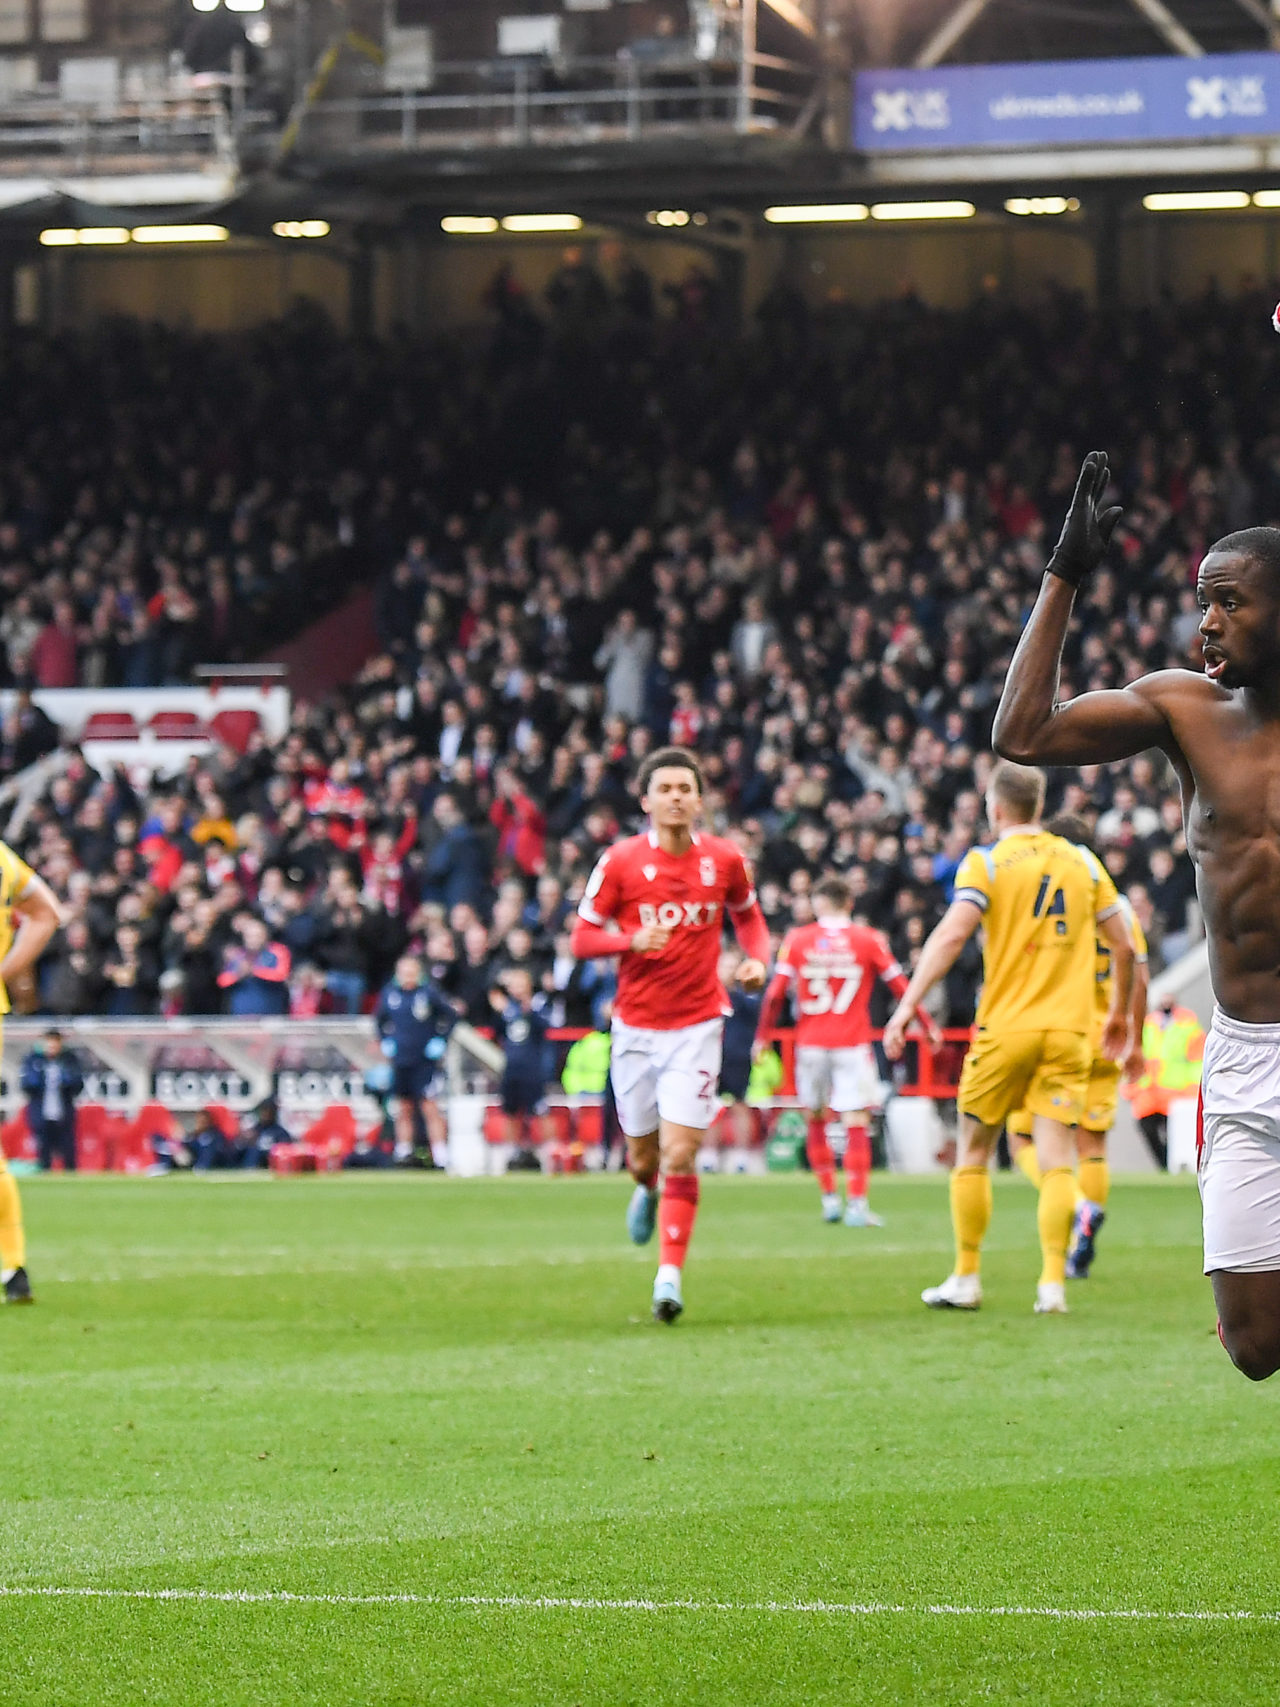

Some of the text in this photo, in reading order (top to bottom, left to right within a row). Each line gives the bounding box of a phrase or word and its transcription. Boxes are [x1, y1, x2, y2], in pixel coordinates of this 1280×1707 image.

[639, 901, 718, 927] BOXT
[1033, 875, 1066, 936] 4
[800, 965, 864, 1014] 37
